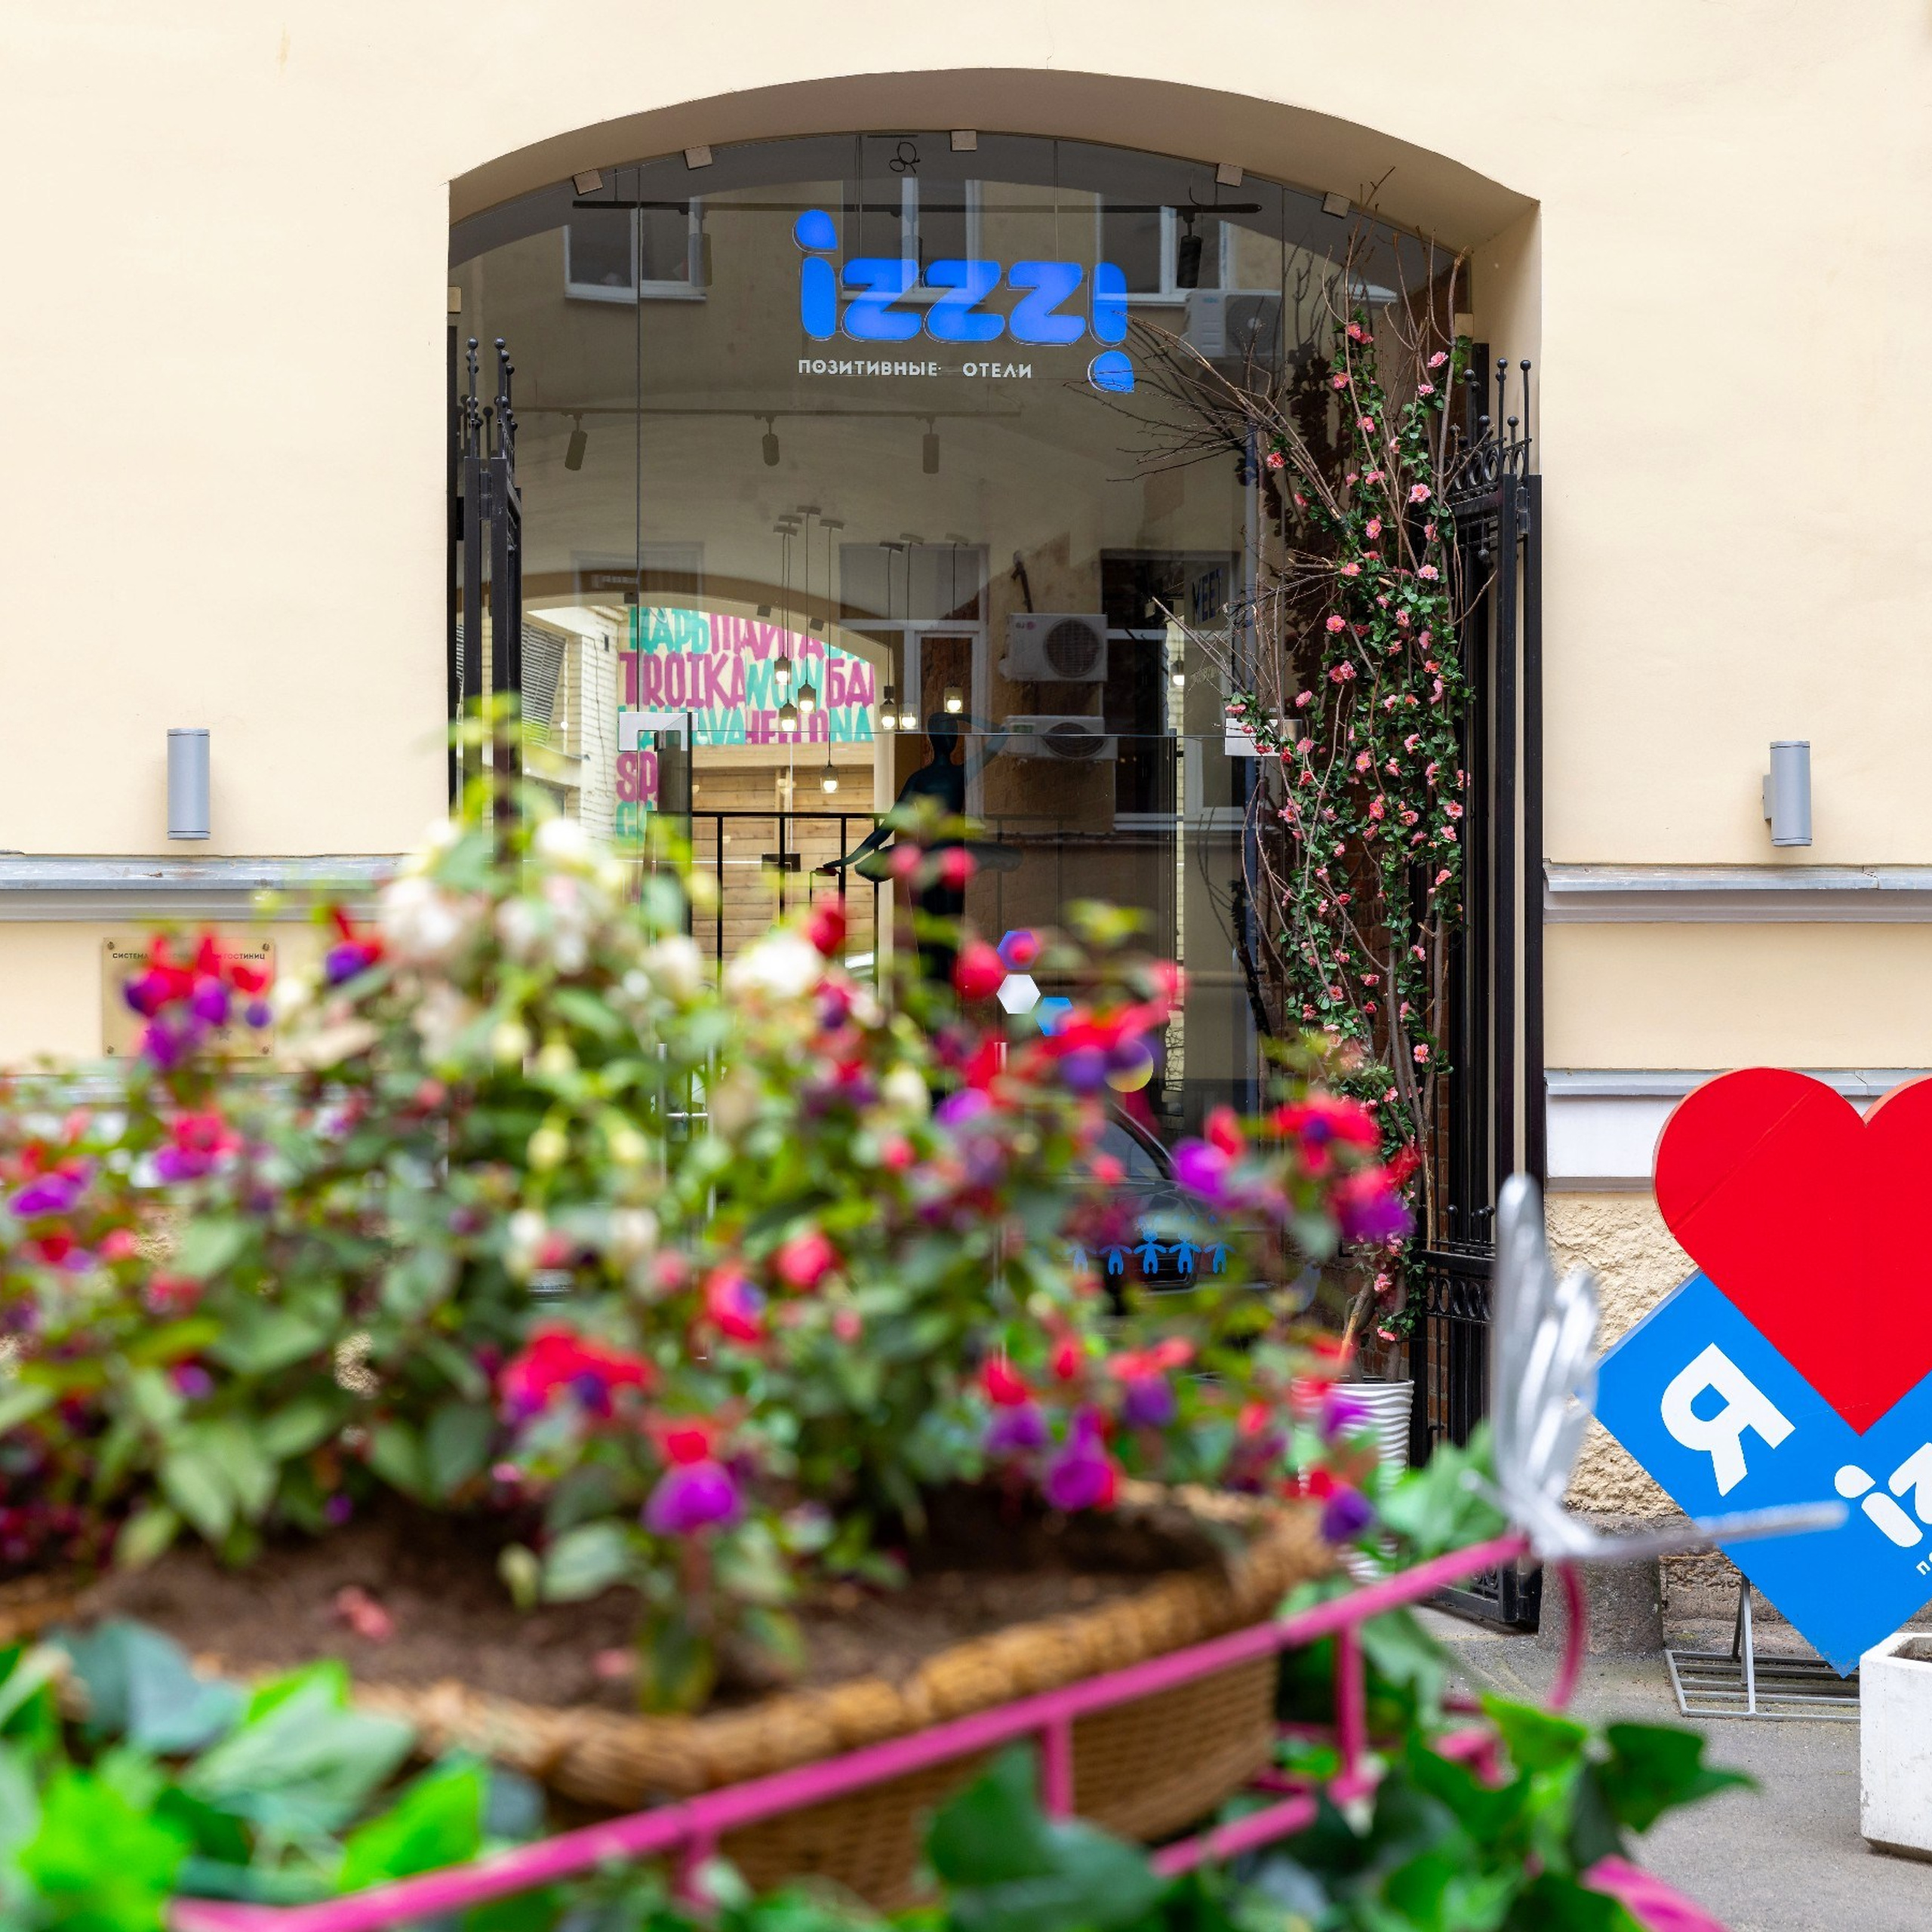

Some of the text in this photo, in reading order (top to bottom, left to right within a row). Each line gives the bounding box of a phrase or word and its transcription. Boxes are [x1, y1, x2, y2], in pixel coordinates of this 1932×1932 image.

[798, 359, 1032, 378] ПОЗИТИВНЫЕ ОТЕЛИ
[619, 652, 746, 711] TROIKA
